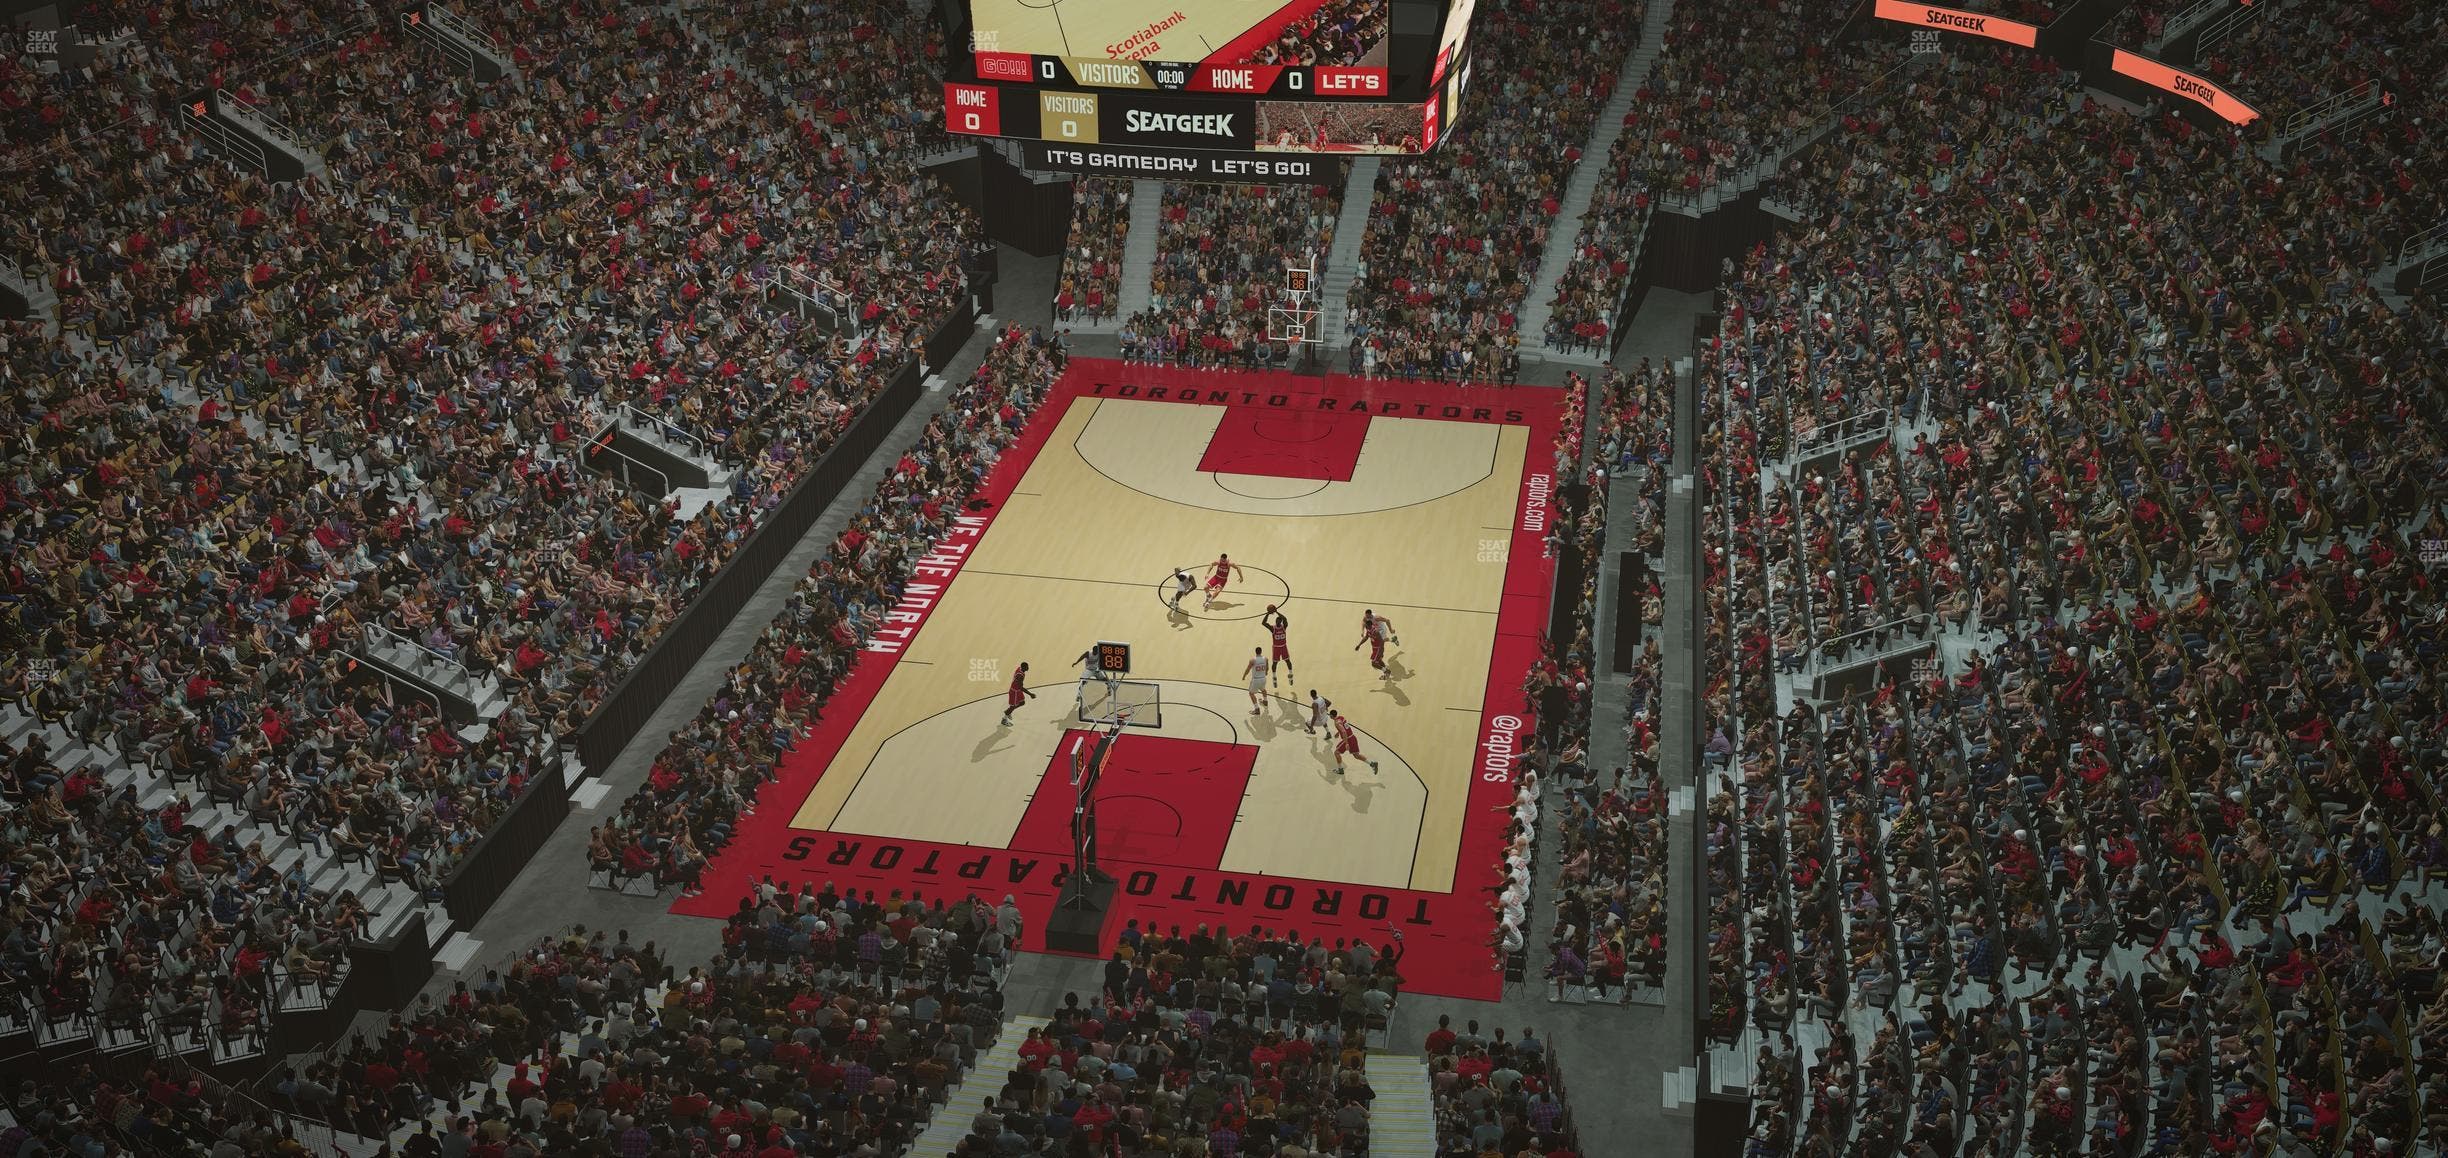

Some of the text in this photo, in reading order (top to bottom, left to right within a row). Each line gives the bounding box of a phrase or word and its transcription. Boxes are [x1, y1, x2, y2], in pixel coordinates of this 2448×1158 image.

[1926, 9, 1986, 32] SEATGEEK
[1105, 9, 1187, 60] Scotiabank
[1113, 41, 1161, 60] rena
[983, 58, 1027, 76] GO!!!
[1042, 61, 1055, 79] 0
[1079, 63, 1139, 85] VISITORS
[1157, 70, 1184, 84] 00:00
[1212, 69, 1253, 90] HOME
[1289, 72, 1303, 90] 0
[1322, 74, 1380, 89] LET'S
[956, 88, 987, 108] HOME
[2173, 75, 2216, 106] SEATGEEK
[1044, 95, 1094, 115] VISITORS
[965, 113, 980, 130] 0
[1062, 120, 1077, 137] 0
[1126, 109, 1235, 137] SEATGEEK
[1047, 150, 1311, 176] IT'S GAMEDAY LET'S GO!
[1094, 383, 1523, 422] TORONTO RAPTORS
[1523, 473, 1552, 531] raptors.com
[1105, 655, 1123, 669] 88
[1482, 715, 1522, 783] @raptors
[1125, 870, 1433, 926] TORONTO
